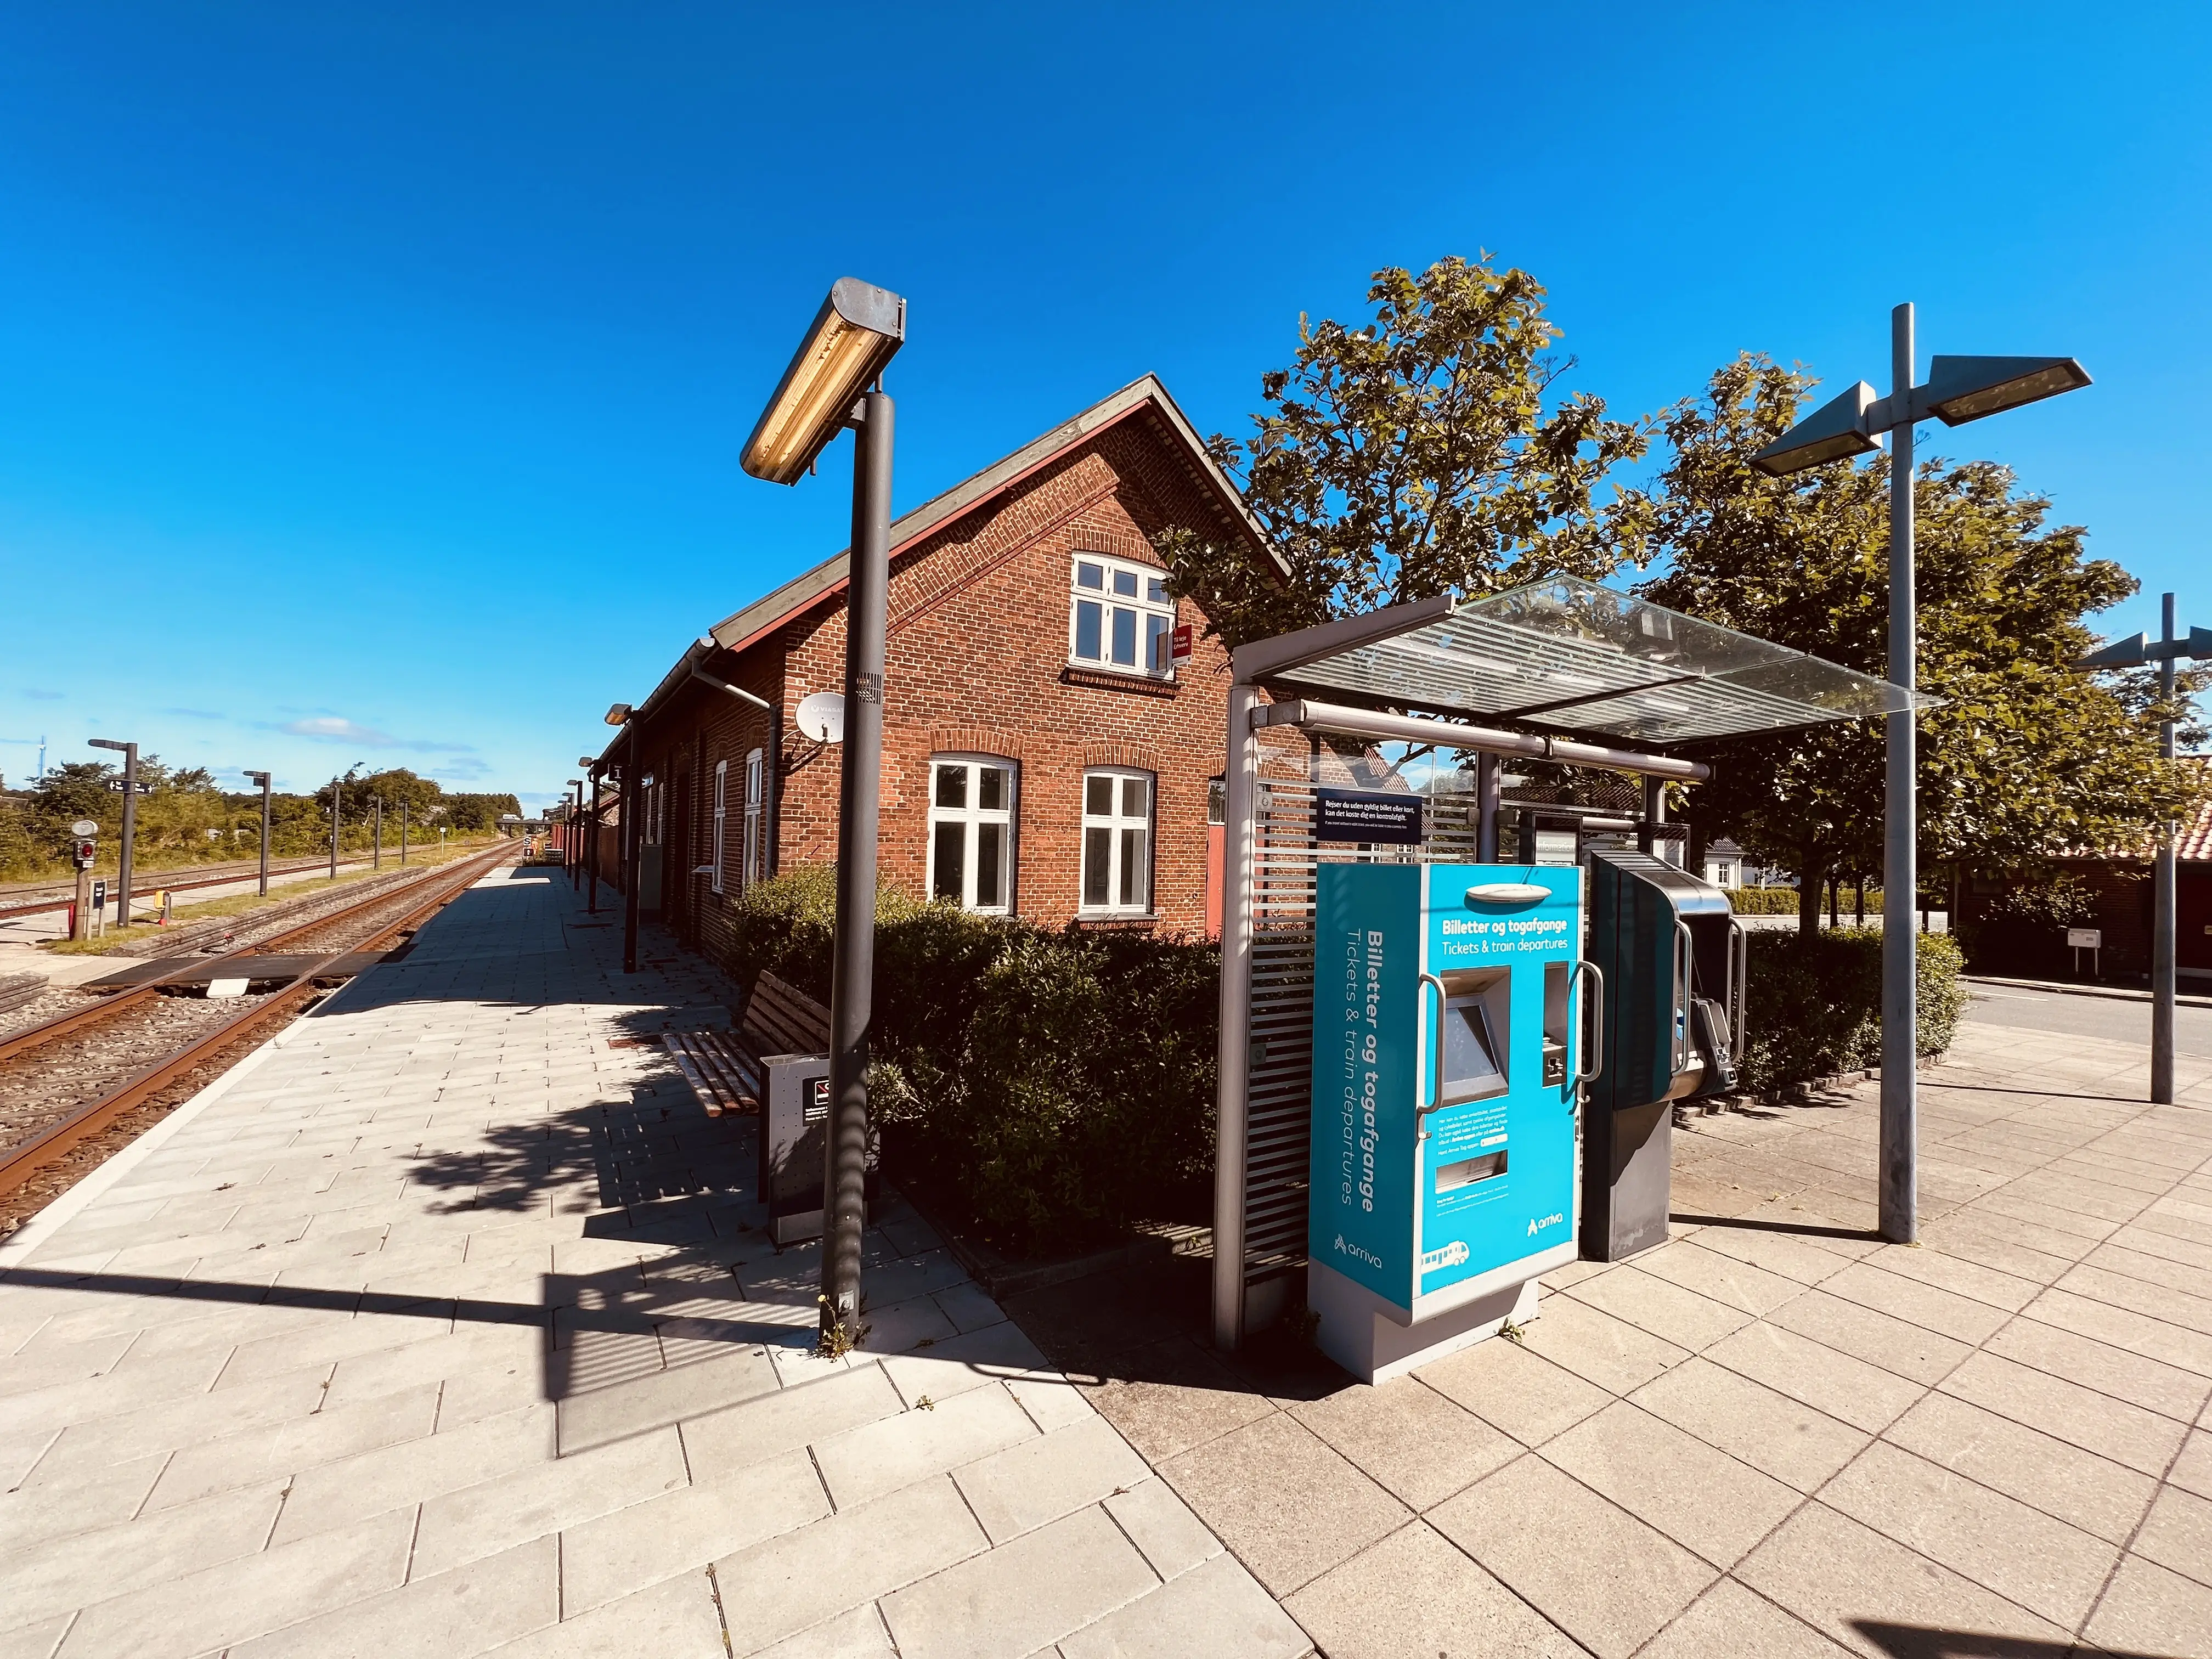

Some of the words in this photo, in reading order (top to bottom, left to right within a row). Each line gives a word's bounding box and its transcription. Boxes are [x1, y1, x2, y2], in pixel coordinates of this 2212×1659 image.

[1361, 811, 1369, 819] dig
[1364, 803, 1379, 812] gyldig
[1404, 806, 1415, 814] kort,
[1442, 919, 1489, 935] Billetter
[1492, 922, 1505, 936] og
[1508, 917, 1567, 935] togafgange
[1442, 941, 1479, 955] Tickets
[1482, 940, 1489, 953] &
[1492, 939, 1515, 952] train
[1517, 938, 1568, 953] departures
[1346, 928, 1361, 1001] Tickets
[1366, 930, 1383, 1029] Billetter
[1346, 1008, 1359, 1022] &
[1345, 1030, 1357, 1079] train
[1361, 1034, 1377, 1064] og
[1341, 1086, 1357, 1205] departures
[1358, 1071, 1379, 1212] togafgange
[1538, 1213, 1563, 1229] arriva
[1348, 1243, 1382, 1269] arriva
